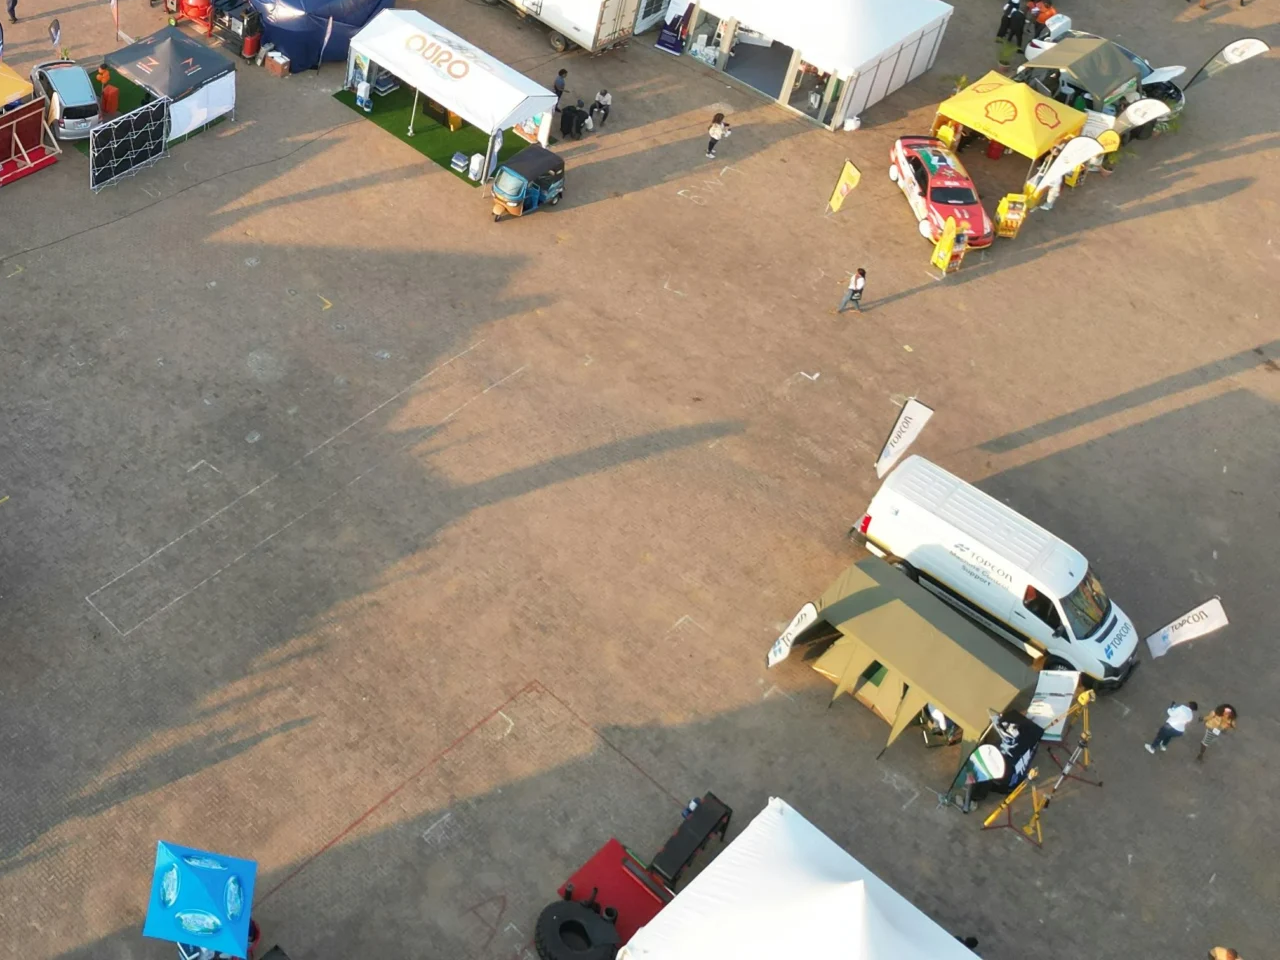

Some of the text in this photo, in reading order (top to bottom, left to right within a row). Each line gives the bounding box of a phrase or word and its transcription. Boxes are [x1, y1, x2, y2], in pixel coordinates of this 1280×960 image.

[889, 415, 913, 449] TOPCON
[961, 565, 992, 587] Support
[971, 551, 1014, 583] TOPCON
[1111, 621, 1133, 650] TOPCON
[1171, 610, 1209, 633] TOPCON
